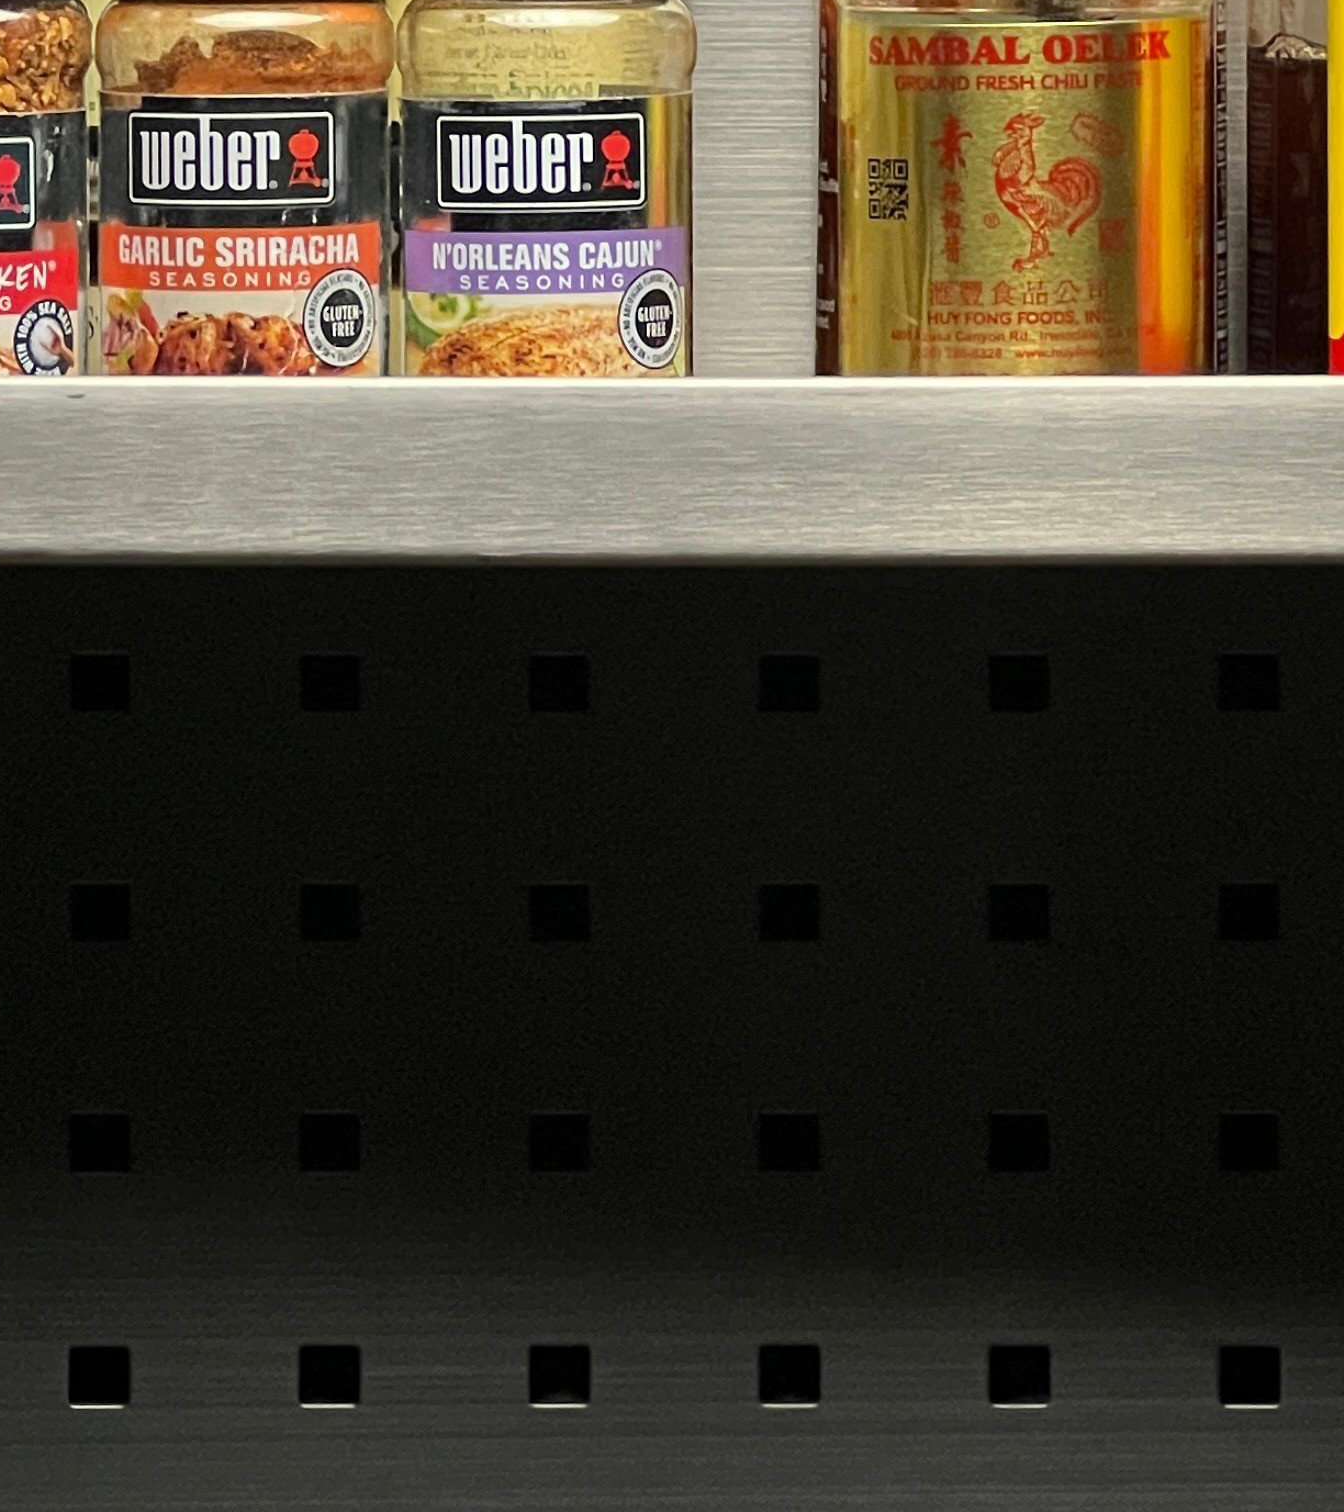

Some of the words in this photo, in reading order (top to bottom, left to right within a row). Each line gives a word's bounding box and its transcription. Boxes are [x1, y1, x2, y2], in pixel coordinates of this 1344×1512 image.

[868, 35, 1031, 65] SAMBAL
[1042, 30, 1171, 64] OELEK
[894, 74, 970, 92] GROUND
[976, 73, 1035, 91] FRESH
[1040, 73, 1088, 90] CHILI
[139, 118, 281, 191] weber
[448, 120, 594, 194] weber
[119, 233, 205, 268] GARLIC
[215, 233, 360, 268] SRIRACHA
[432, 242, 570, 271] N'ORLEANS
[578, 240, 654, 269] CAJUN
[149, 270, 312, 288] SEASONING
[459, 272, 625, 292] SEASONING
[927, 311, 960, 326] HUY
[965, 311, 1012, 326] FONG
[1017, 310, 1079, 326] FOODS,
[331, 320, 356, 338] FREE
[646, 321, 667, 338] FREE
